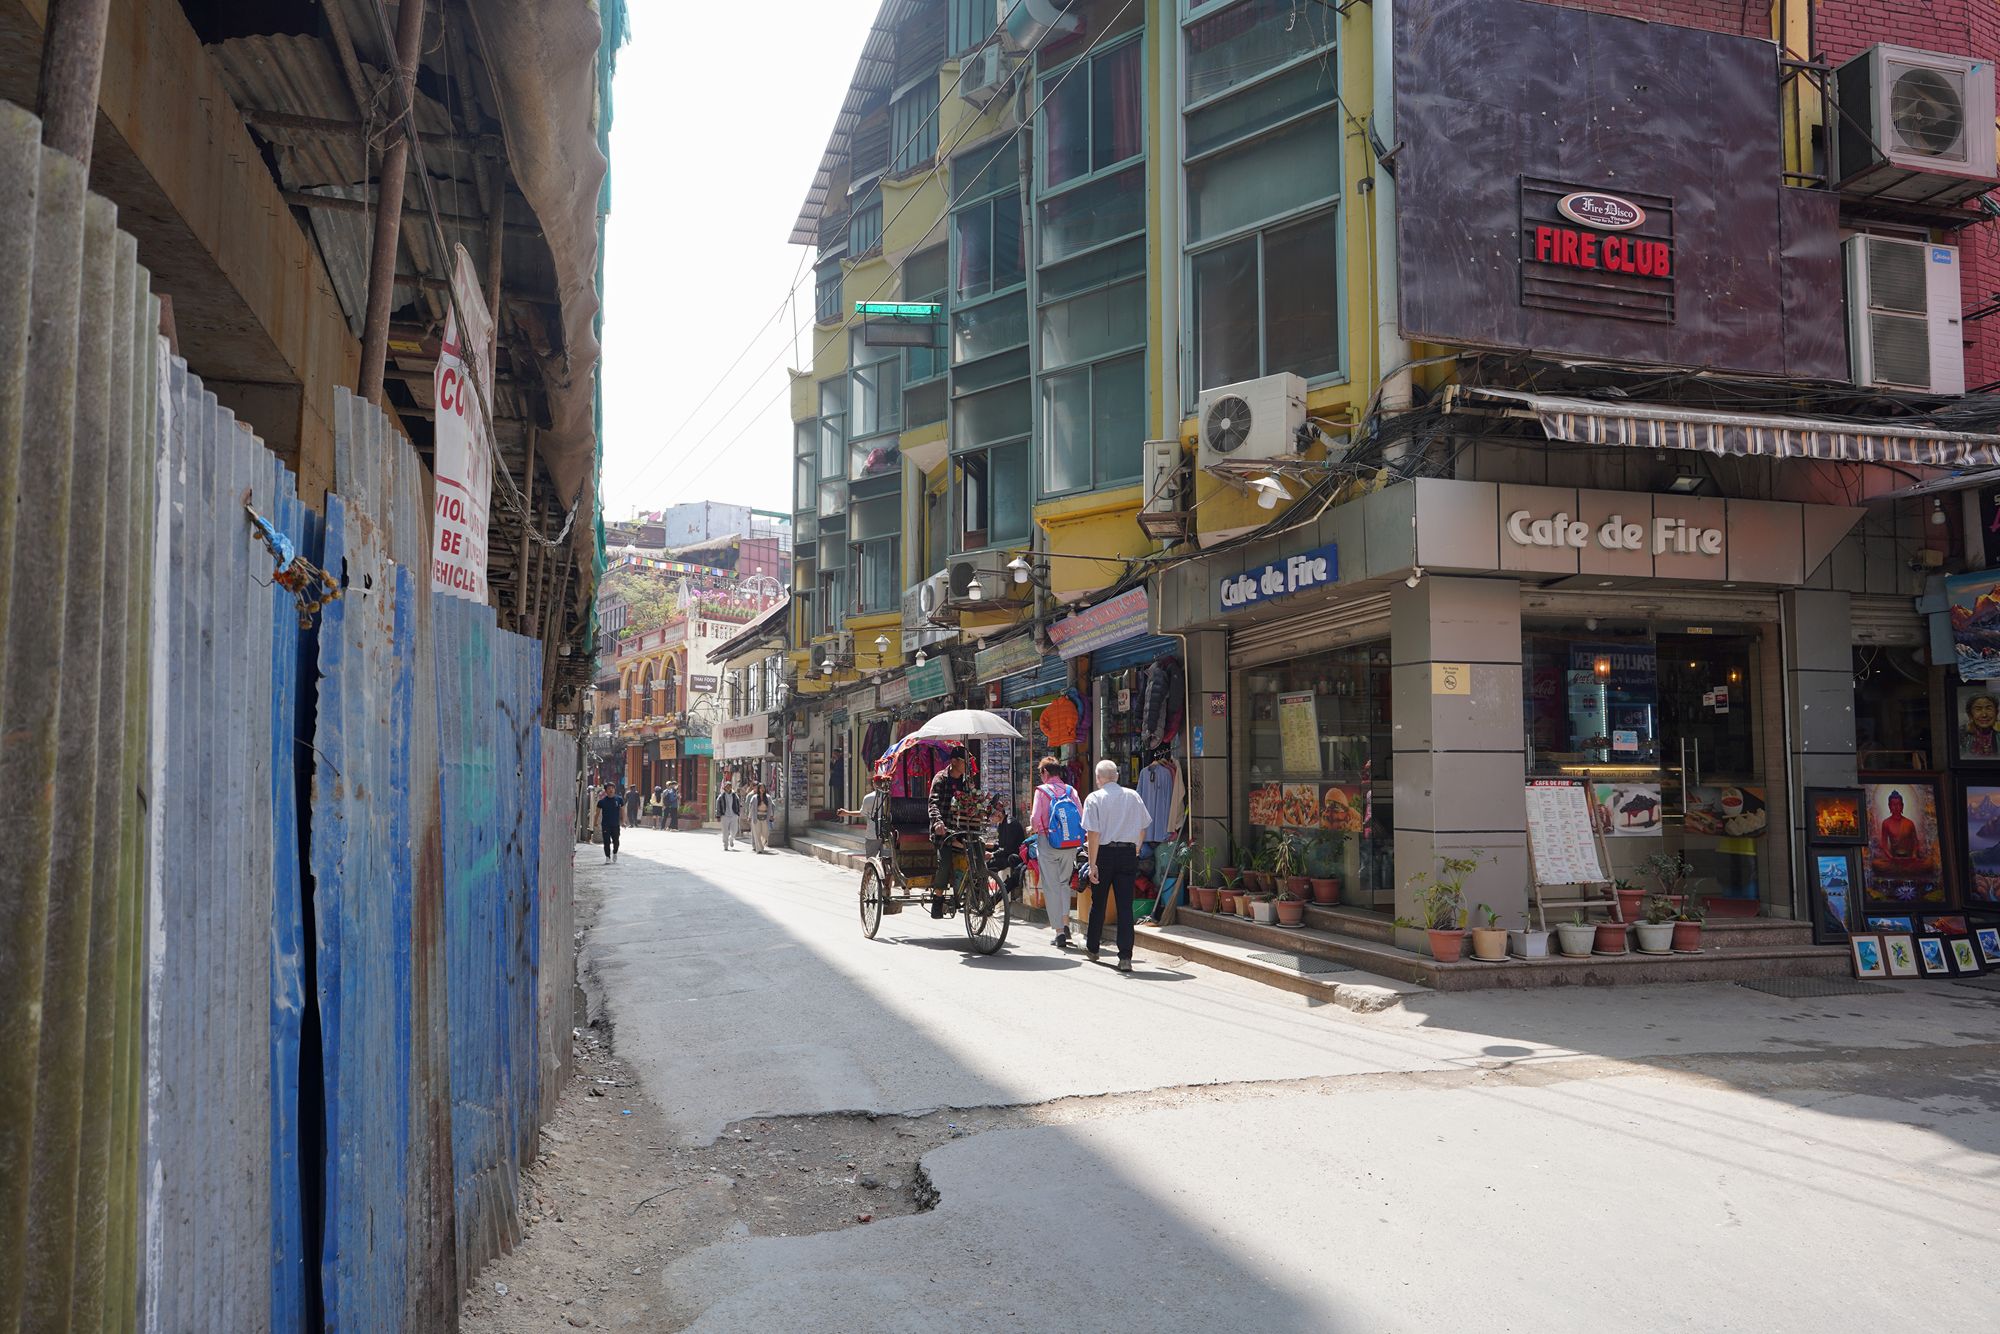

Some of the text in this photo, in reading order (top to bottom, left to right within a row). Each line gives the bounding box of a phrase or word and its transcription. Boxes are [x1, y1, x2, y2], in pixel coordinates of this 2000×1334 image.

[1581, 197, 1634, 218] Fire Disco
[1536, 226, 1670, 277] FIRE CLUB
[440, 529, 462, 556] BE
[1507, 510, 1722, 555] Cafe de Fire
[1221, 555, 1327, 607] Cafe de Fire
